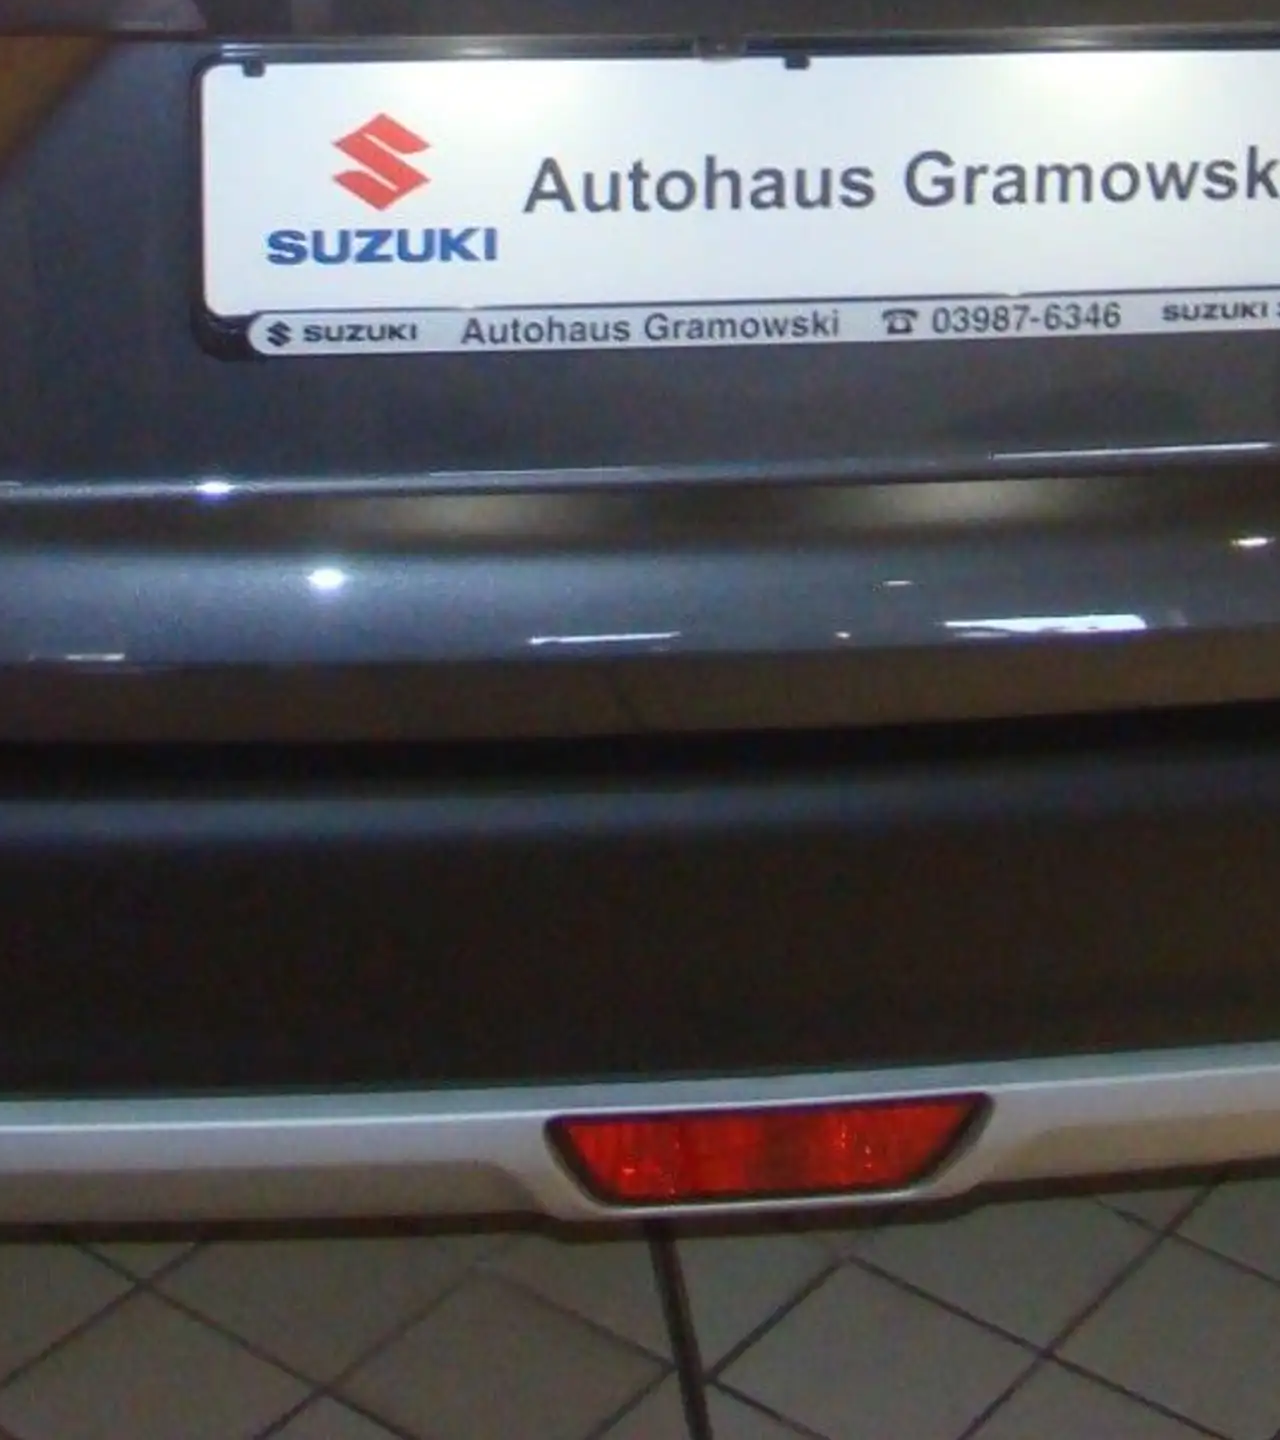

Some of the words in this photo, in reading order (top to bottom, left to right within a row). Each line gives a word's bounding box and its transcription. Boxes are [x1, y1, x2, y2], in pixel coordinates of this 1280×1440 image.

[522, 155, 876, 213] Autohaus
[266, 227, 499, 265] SUZUKI
[303, 323, 418, 343] SUZUKI
[460, 316, 631, 345] Autohaus
[643, 308, 840, 342] Gramowski
[931, 301, 1122, 335] 03987-6346
[1161, 301, 1269, 322] SUZUKI
